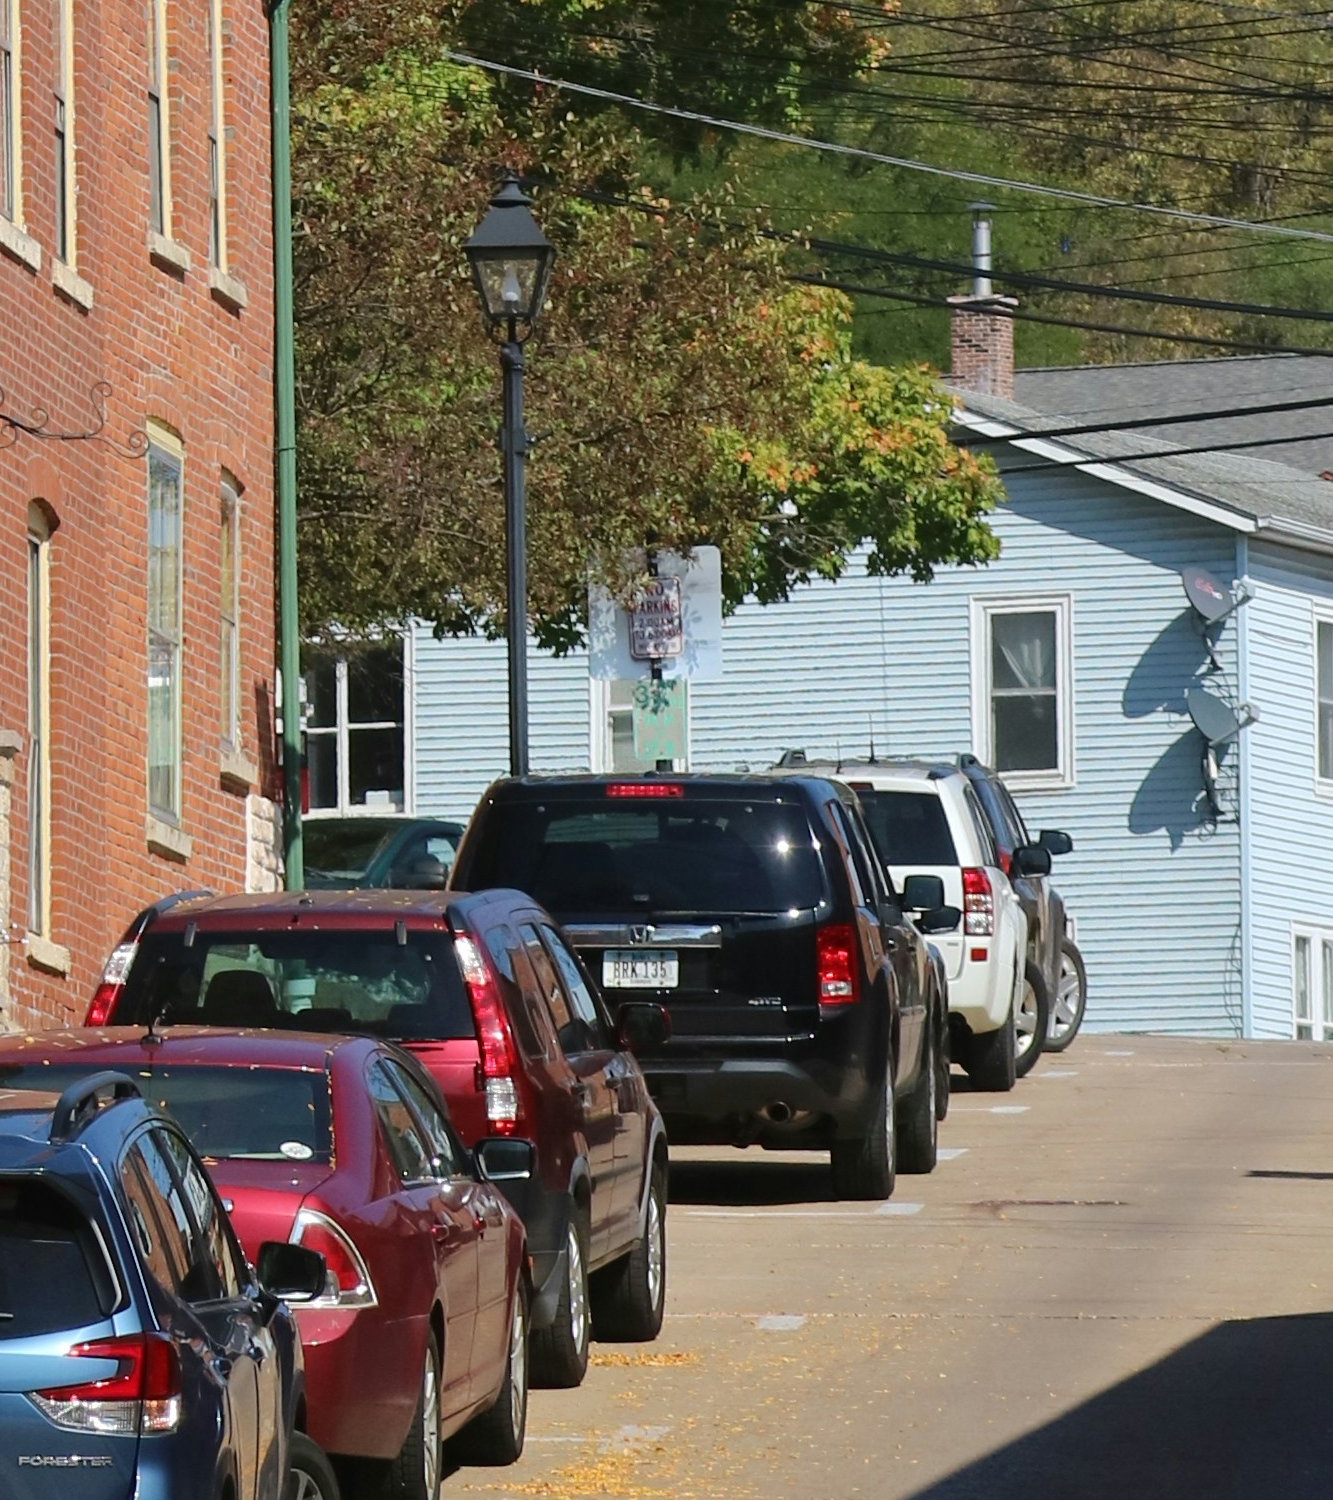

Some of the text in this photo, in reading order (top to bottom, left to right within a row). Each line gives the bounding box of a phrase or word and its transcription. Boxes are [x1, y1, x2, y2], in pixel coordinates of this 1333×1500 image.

[639, 599, 678, 613] ARKING
[644, 961, 667, 979] 135
[18, 1455, 113, 1467] FORESTER
